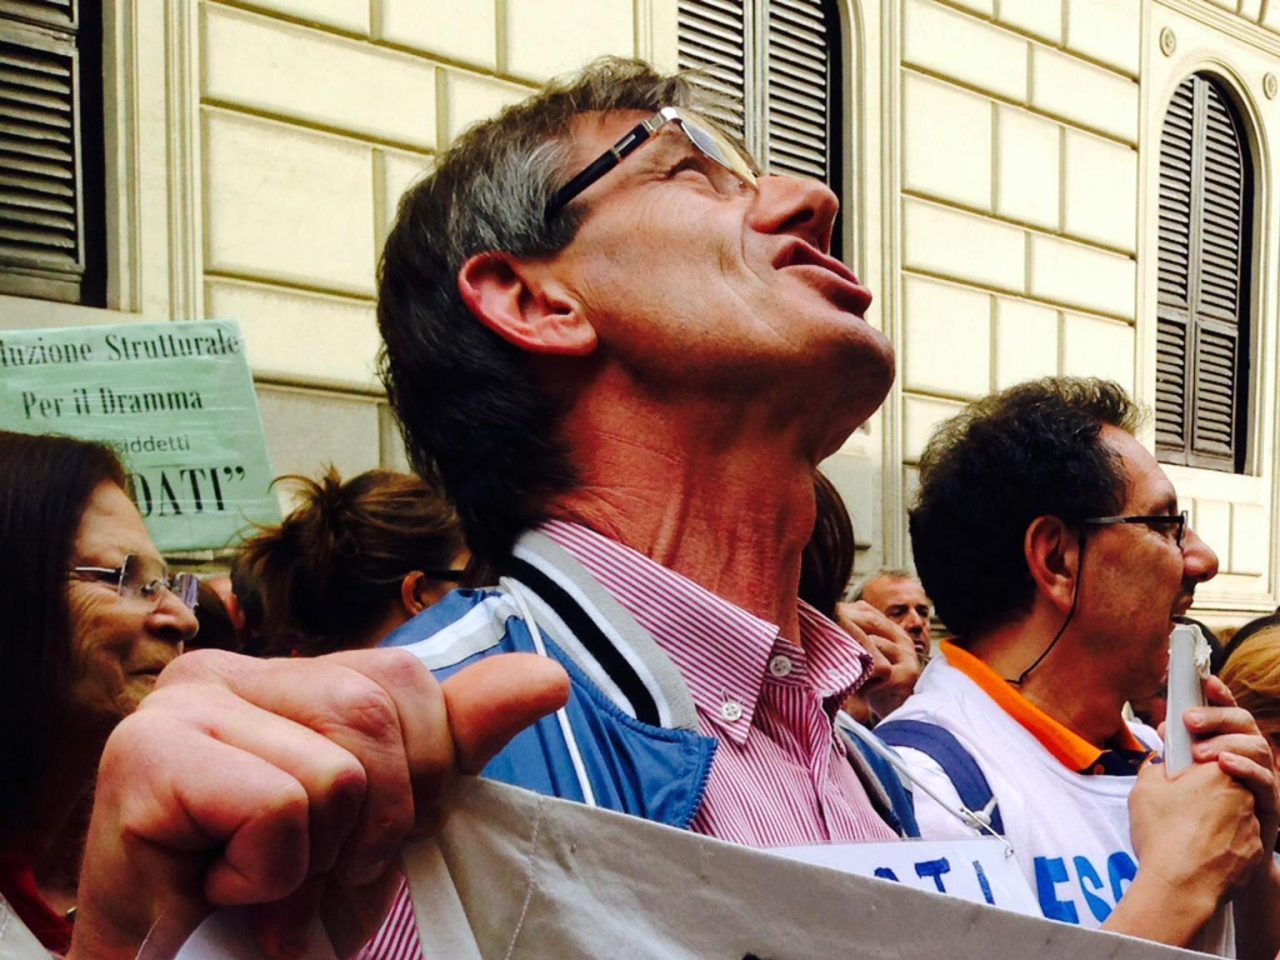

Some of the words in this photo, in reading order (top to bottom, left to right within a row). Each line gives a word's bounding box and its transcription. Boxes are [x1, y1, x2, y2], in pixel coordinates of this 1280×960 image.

[105, 329, 240, 361] Strutturale
[22, 391, 63, 419] Per
[74, 388, 91, 415] il
[101, 387, 203, 415] Dramma
[873, 857, 996, 905] TI
